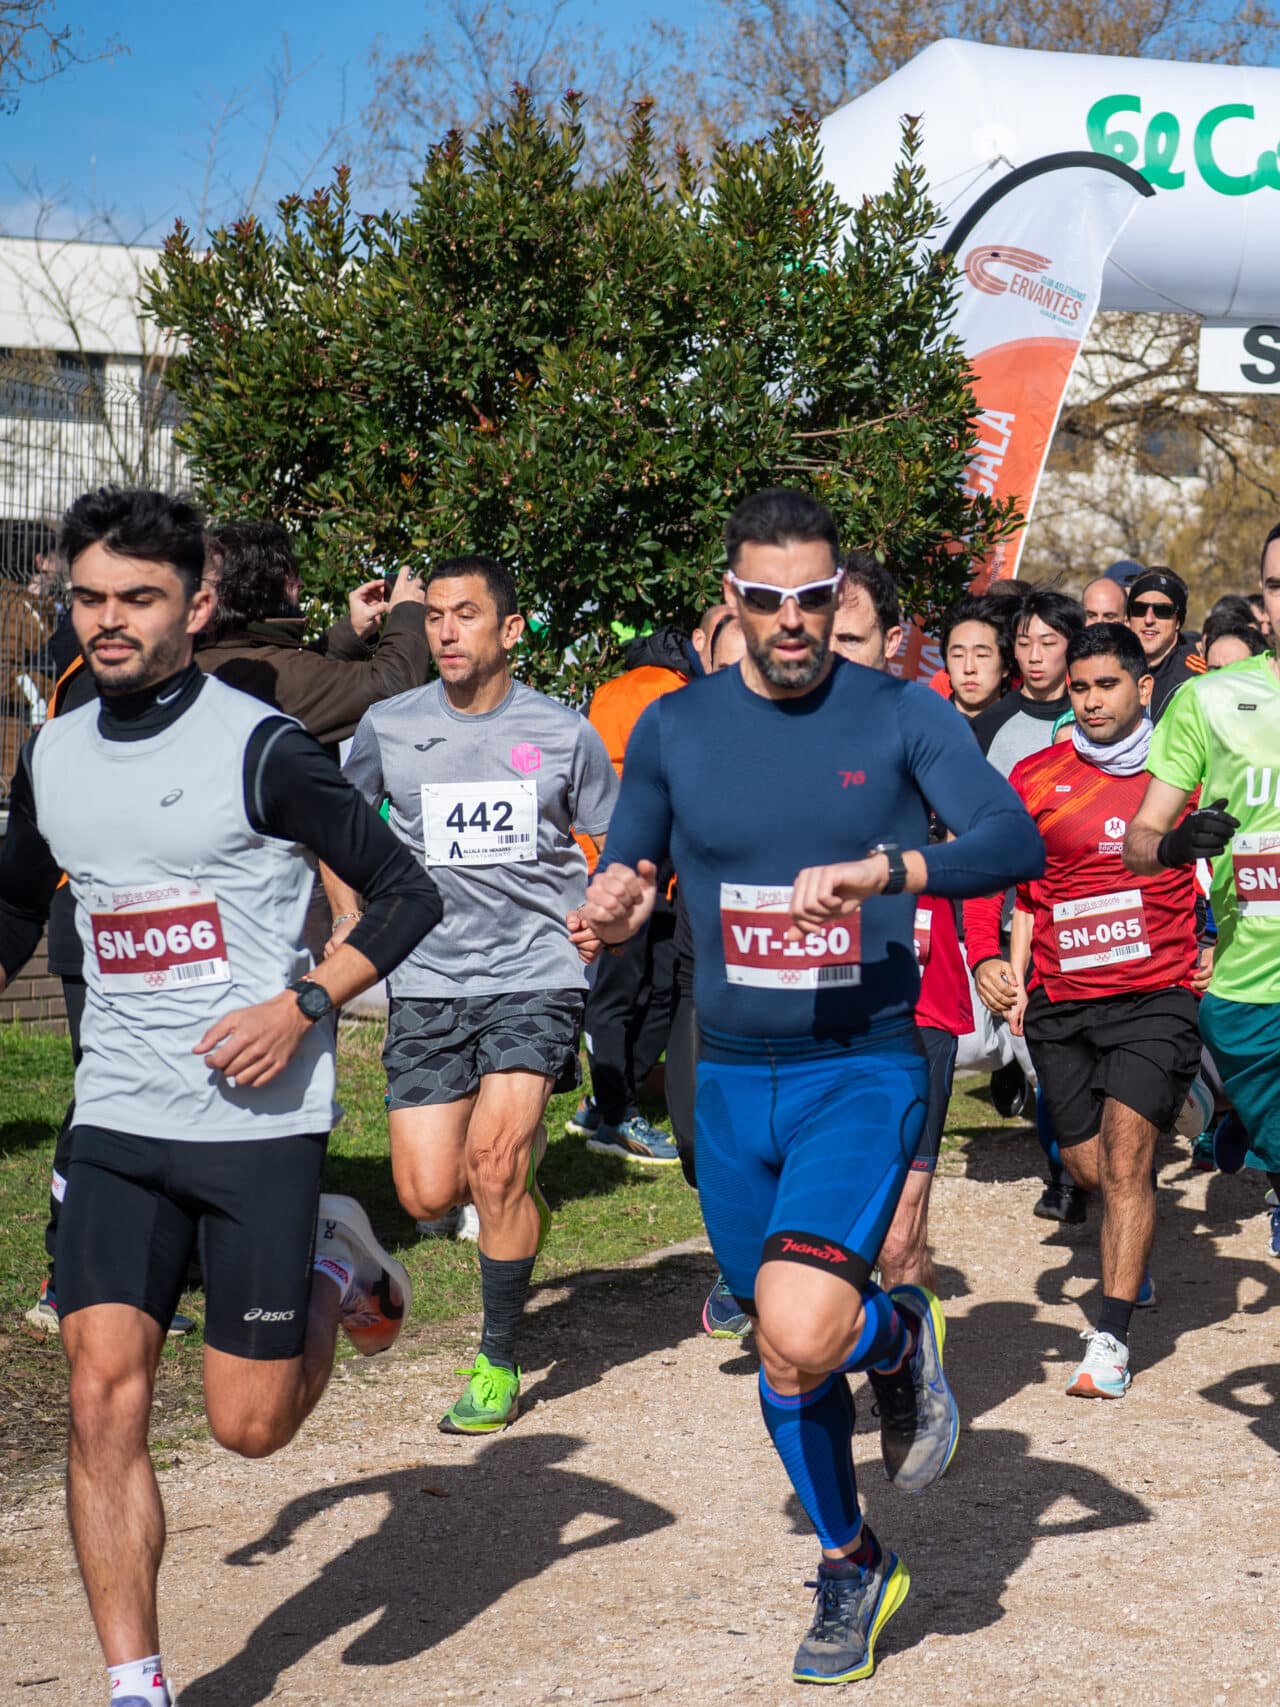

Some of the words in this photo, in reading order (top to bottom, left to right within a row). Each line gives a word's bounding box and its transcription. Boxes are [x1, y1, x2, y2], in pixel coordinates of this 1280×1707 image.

[1085, 94, 1185, 190] El
[446, 801, 514, 832] 442
[98, 920, 216, 960] SN-066
[731, 926, 850, 957] VT-150
[1058, 918, 1141, 950] SN-065
